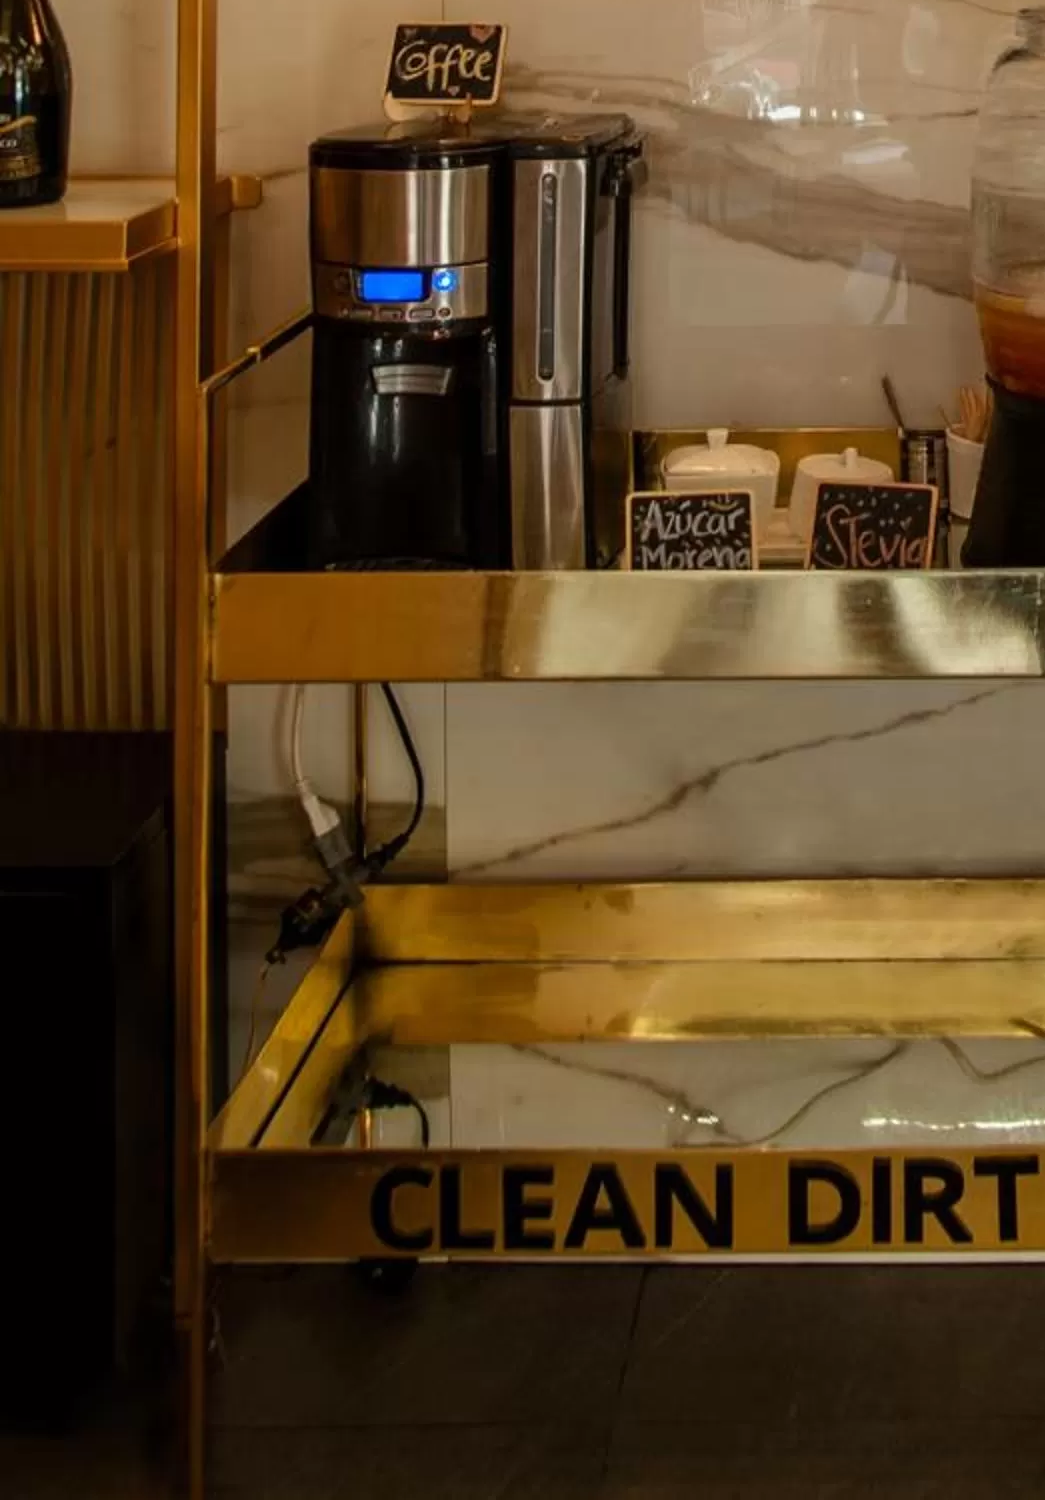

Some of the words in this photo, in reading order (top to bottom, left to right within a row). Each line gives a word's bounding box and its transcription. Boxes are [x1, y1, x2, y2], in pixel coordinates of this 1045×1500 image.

[394, 39, 493, 92] Coffee
[641, 543, 750, 570] Morena
[370, 1161, 734, 1251] CLEAN
